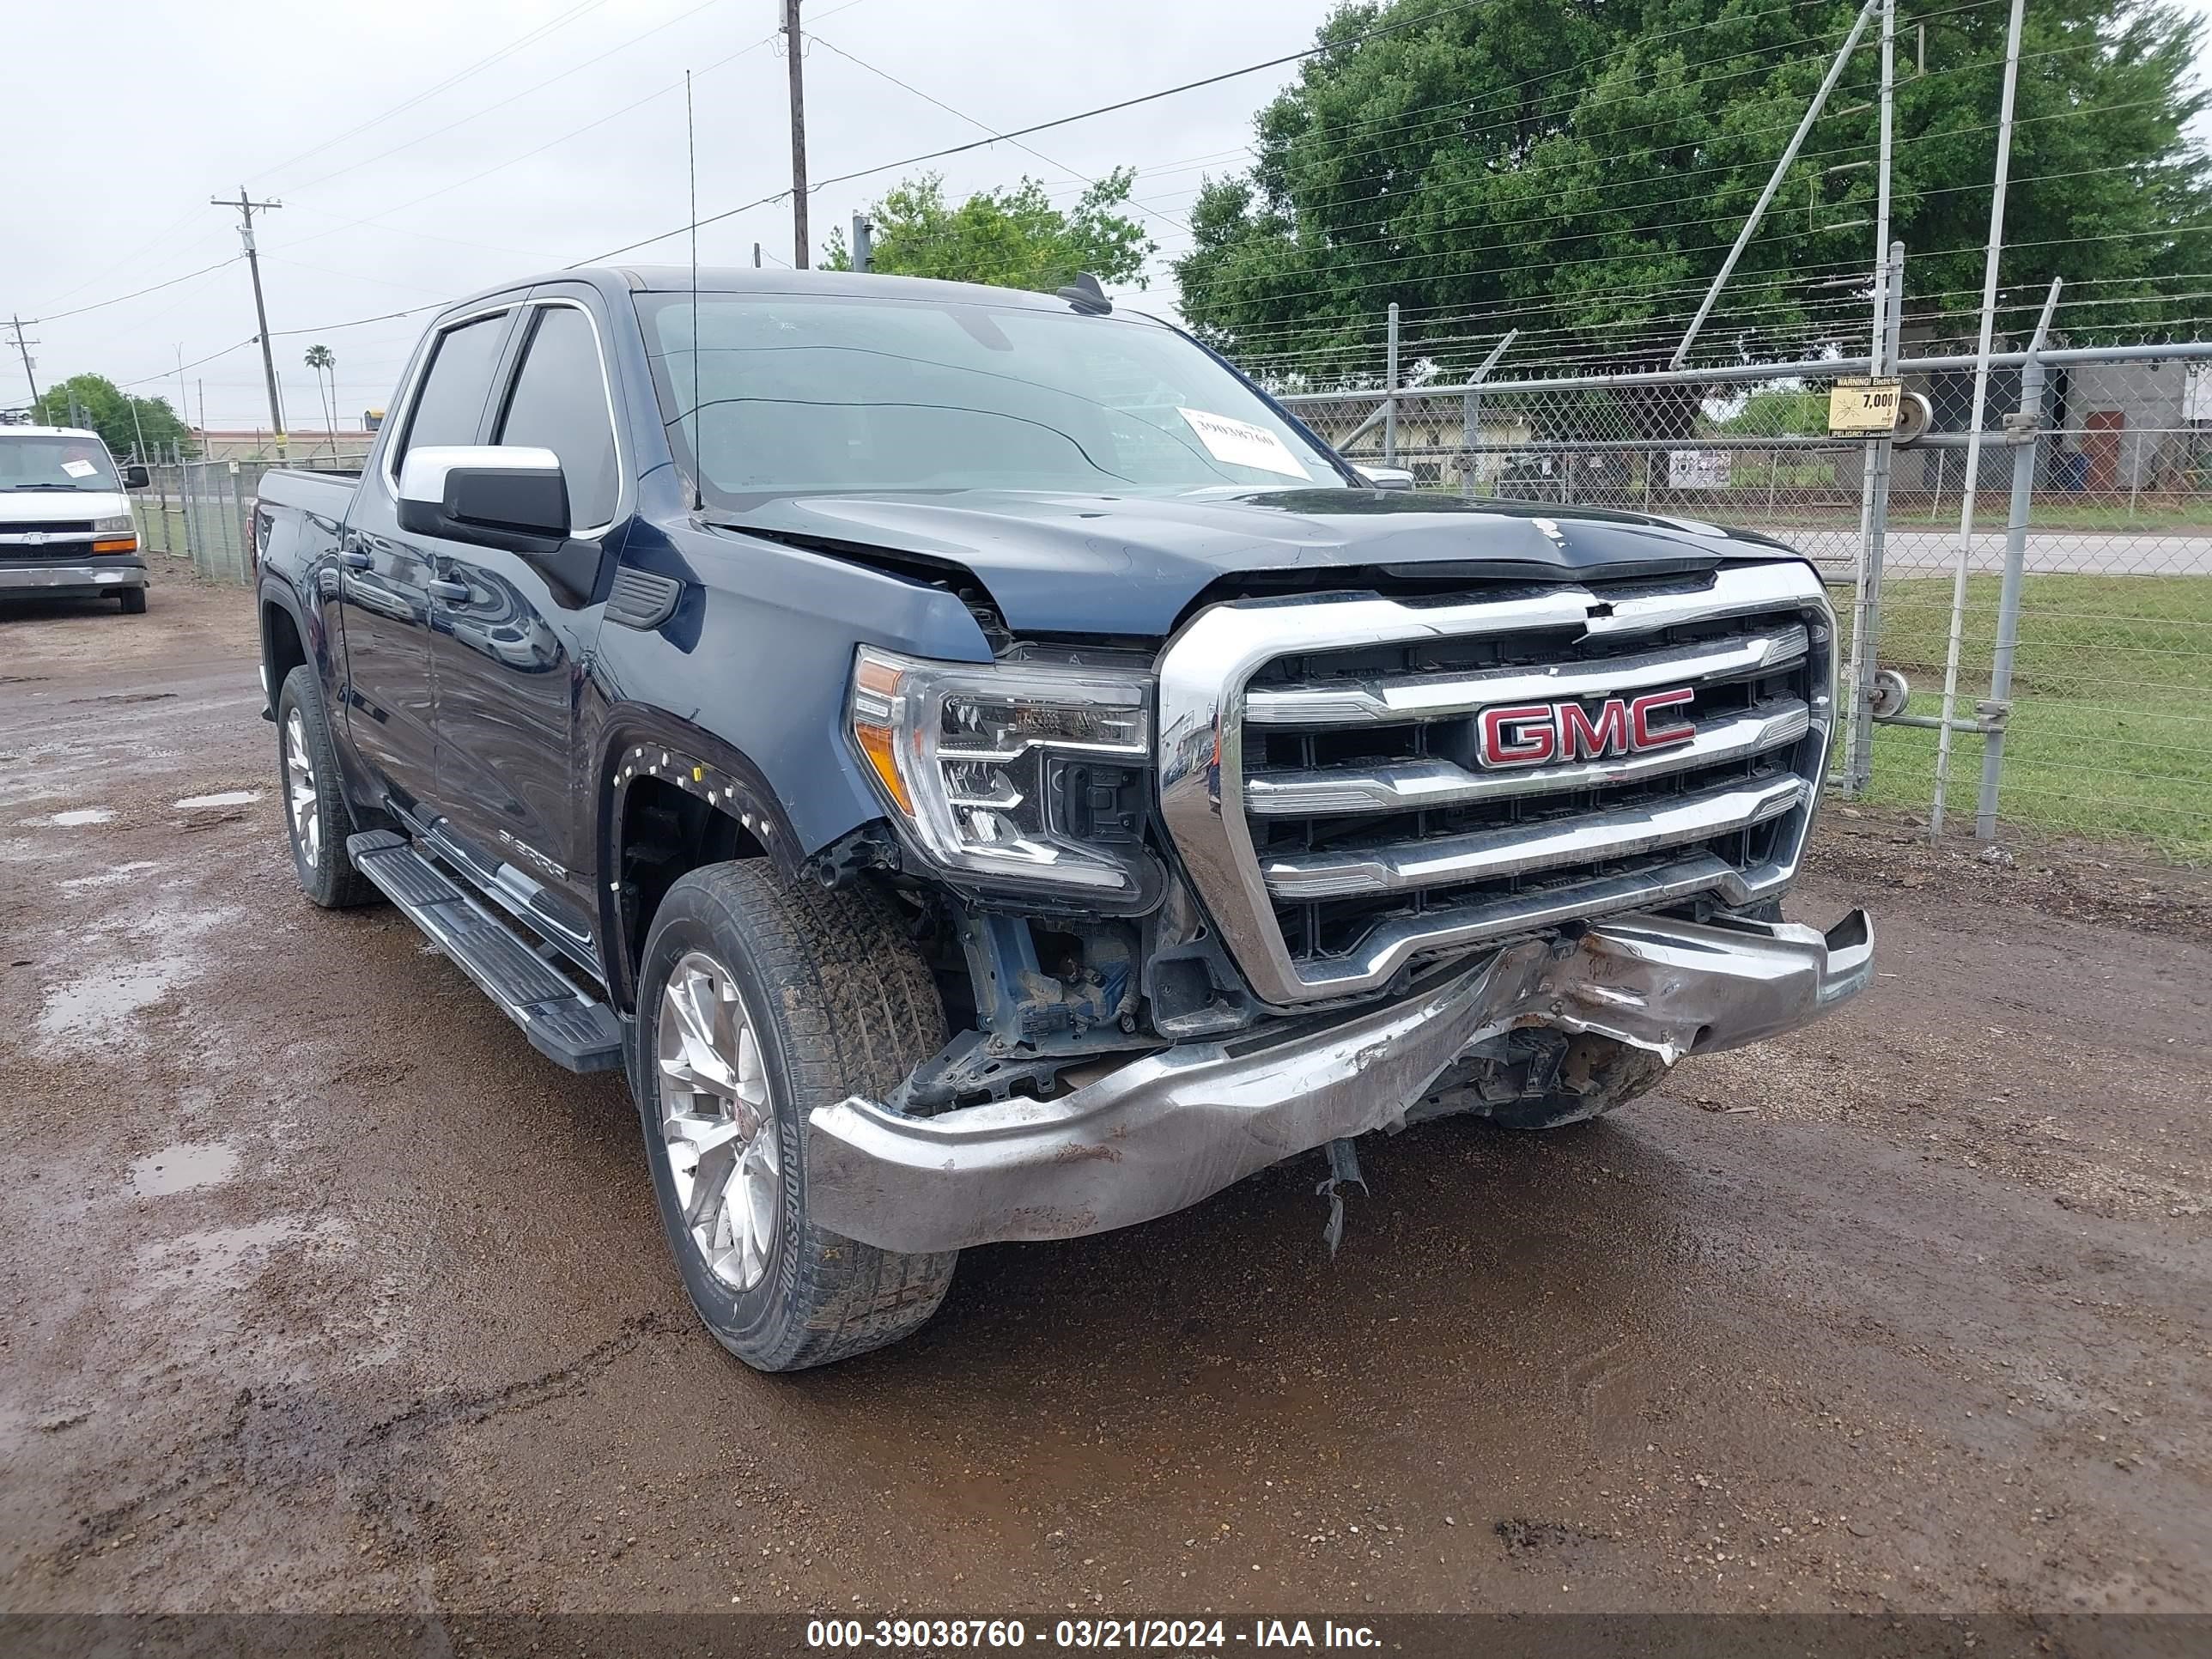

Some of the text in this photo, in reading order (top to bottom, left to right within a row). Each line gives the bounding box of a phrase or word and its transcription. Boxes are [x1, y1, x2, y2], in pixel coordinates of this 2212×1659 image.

[1837, 377, 1871, 386] WARNING!
[1863, 393, 1893, 410] 7,000
[1478, 687, 1697, 769] GMC
[779, 1121, 801, 1303] BRIDGESTONE
